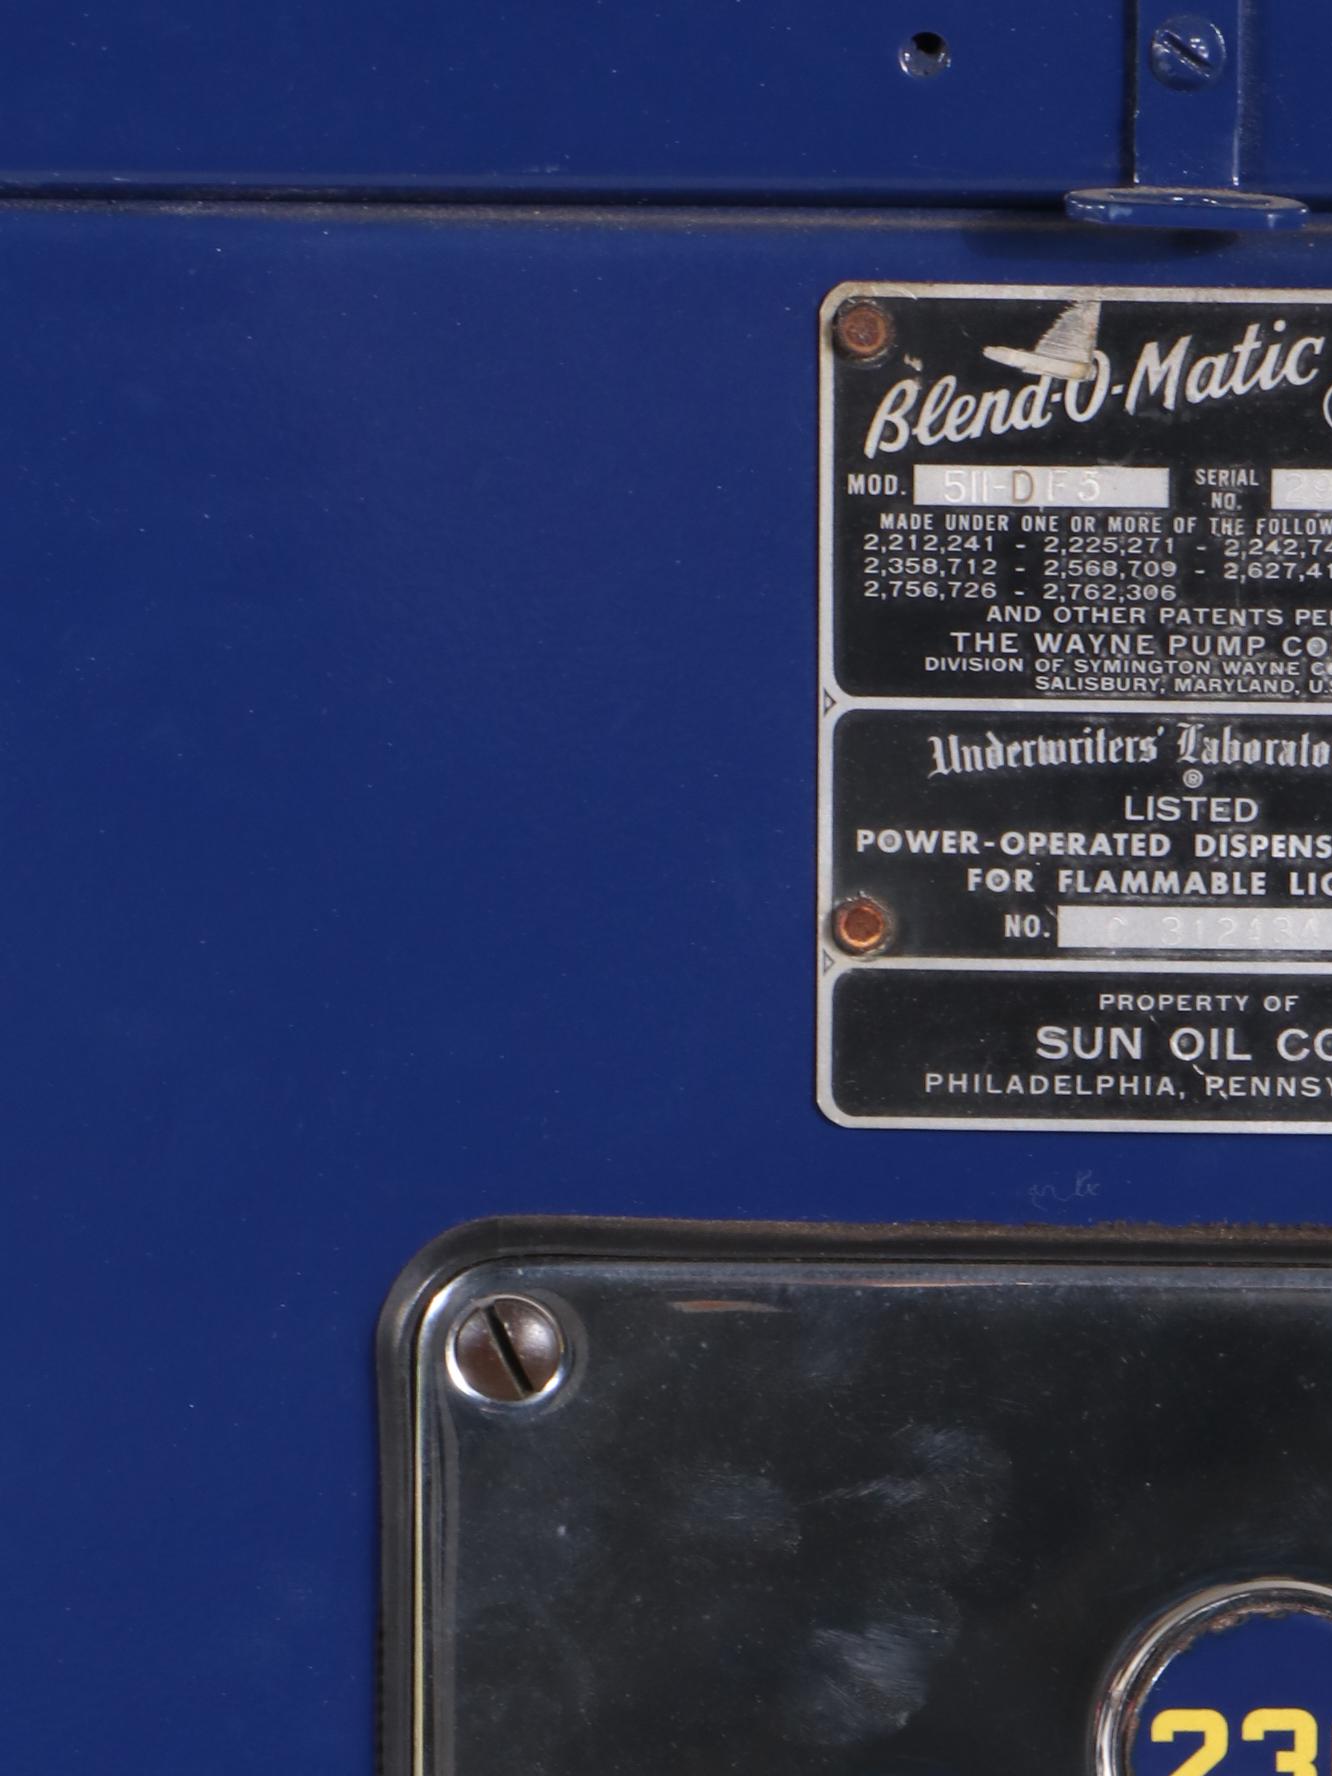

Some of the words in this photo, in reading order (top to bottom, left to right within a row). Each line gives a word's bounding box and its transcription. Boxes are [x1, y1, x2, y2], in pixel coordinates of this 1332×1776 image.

[848, 473, 906, 496] MOD.
[1195, 468, 1260, 487] SERIAL
[1211, 492, 1242, 511] NO.
[879, 512, 934, 531] MADE
[944, 513, 1009, 532] UNDER
[1021, 514, 1059, 533] ONE
[1070, 515, 1097, 533] OR
[1107, 515, 1162, 534] MORE
[1173, 516, 1197, 535] OF
[1209, 517, 1245, 536] THE
[863, 533, 995, 554] 2,212,241
[1043, 536, 1175, 556] 2,225,271
[863, 557, 997, 577] 2,358,712
[1043, 560, 1178, 580] 2,568,709
[863, 581, 998, 600] 2,756,726
[1043, 583, 1177, 603] 2,762,306
[986, 605, 1041, 624] AND
[1053, 606, 1146, 625] OTHER
[1159, 607, 1284, 627] PATENTS
[950, 632, 1019, 654] THE
[1034, 633, 1155, 656] WAYNE
[1168, 635, 1266, 657] PUMP
[925, 657, 1024, 673] DIVISION
[1035, 658, 1064, 674] OF
[1074, 659, 1211, 675] SYMINGTON
[1223, 661, 1300, 676] WAYNE
[1035, 676, 1168, 694] SALISBURY,
[1174, 678, 1300, 696] MARYLAND,
[928, 726, 1165, 779] Underwriters'
[1125, 796, 1258, 822] LISTED
[857, 830, 1172, 857] POWER-OPERATED
[968, 868, 1035, 892] FOR
[1058, 870, 1267, 896] FLAMMABLE
[1004, 914, 1050, 939] NO.
[1100, 993, 1249, 1012] PROPERTY
[1264, 995, 1299, 1013] OF
[1036, 1027, 1143, 1060] SUN
[1169, 1028, 1252, 1061] OIL
[925, 1074, 1186, 1099] PHILADELPHIA,
